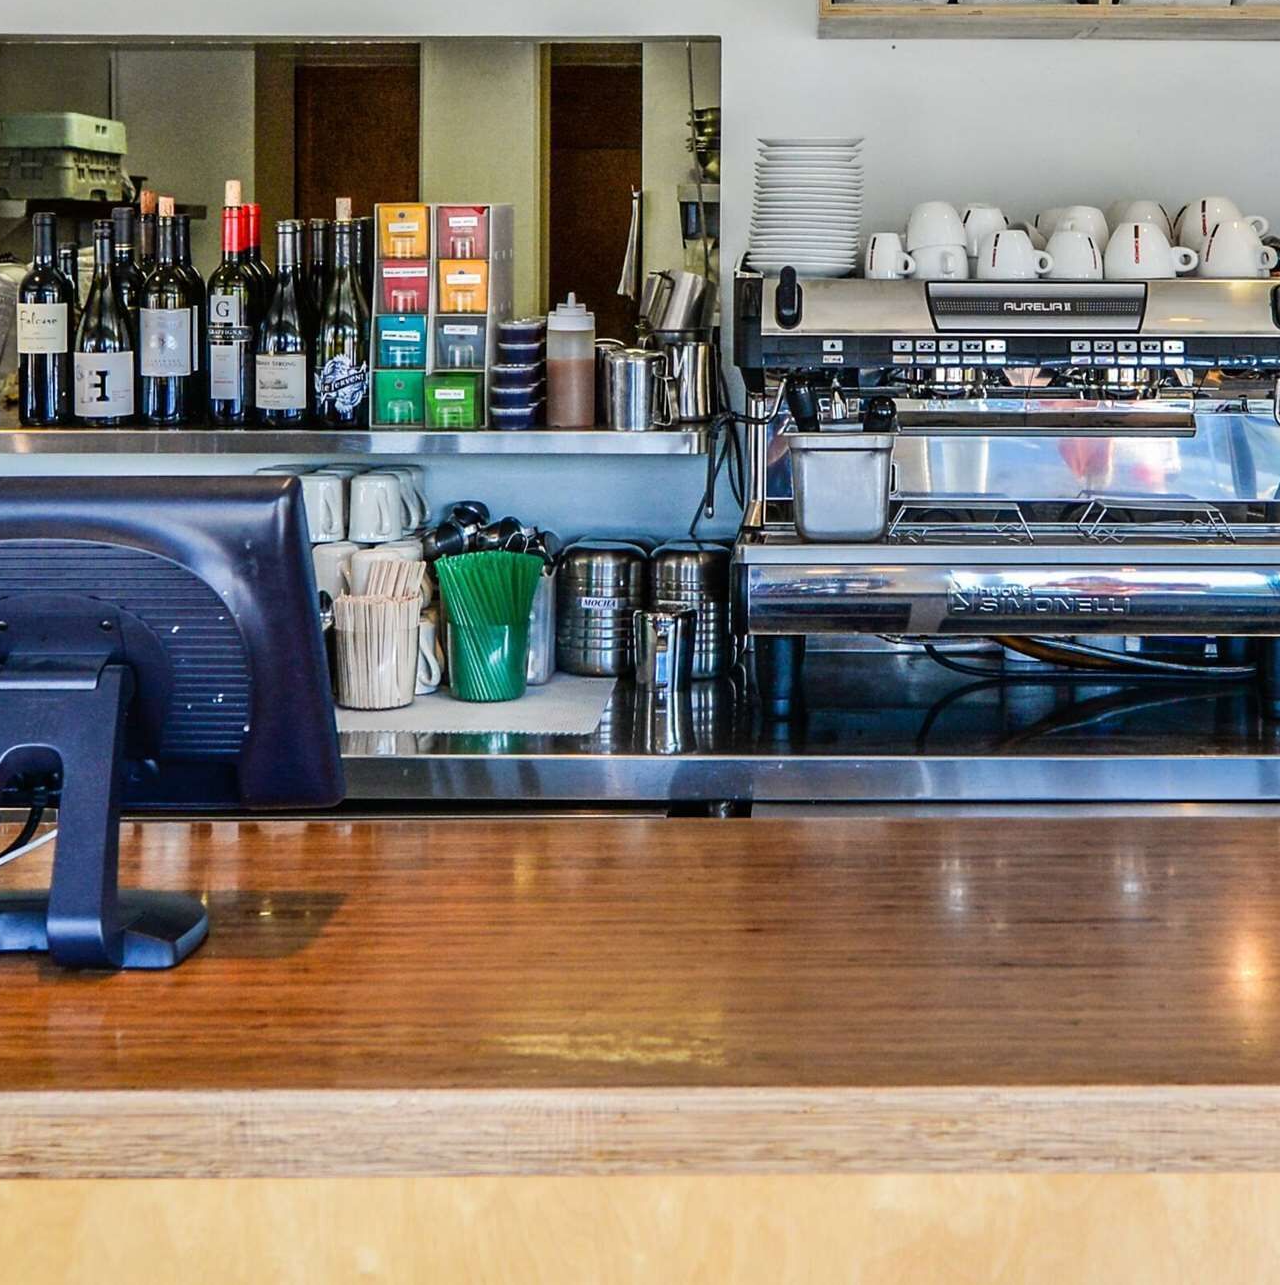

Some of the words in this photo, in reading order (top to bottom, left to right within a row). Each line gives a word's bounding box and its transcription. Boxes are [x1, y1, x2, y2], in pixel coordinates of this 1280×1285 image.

[215, 301, 230, 318] G
[1003, 302, 1063, 312] AURELIA
[582, 598, 616, 608] MOCHA
[979, 596, 1131, 613] SIMONELLI
